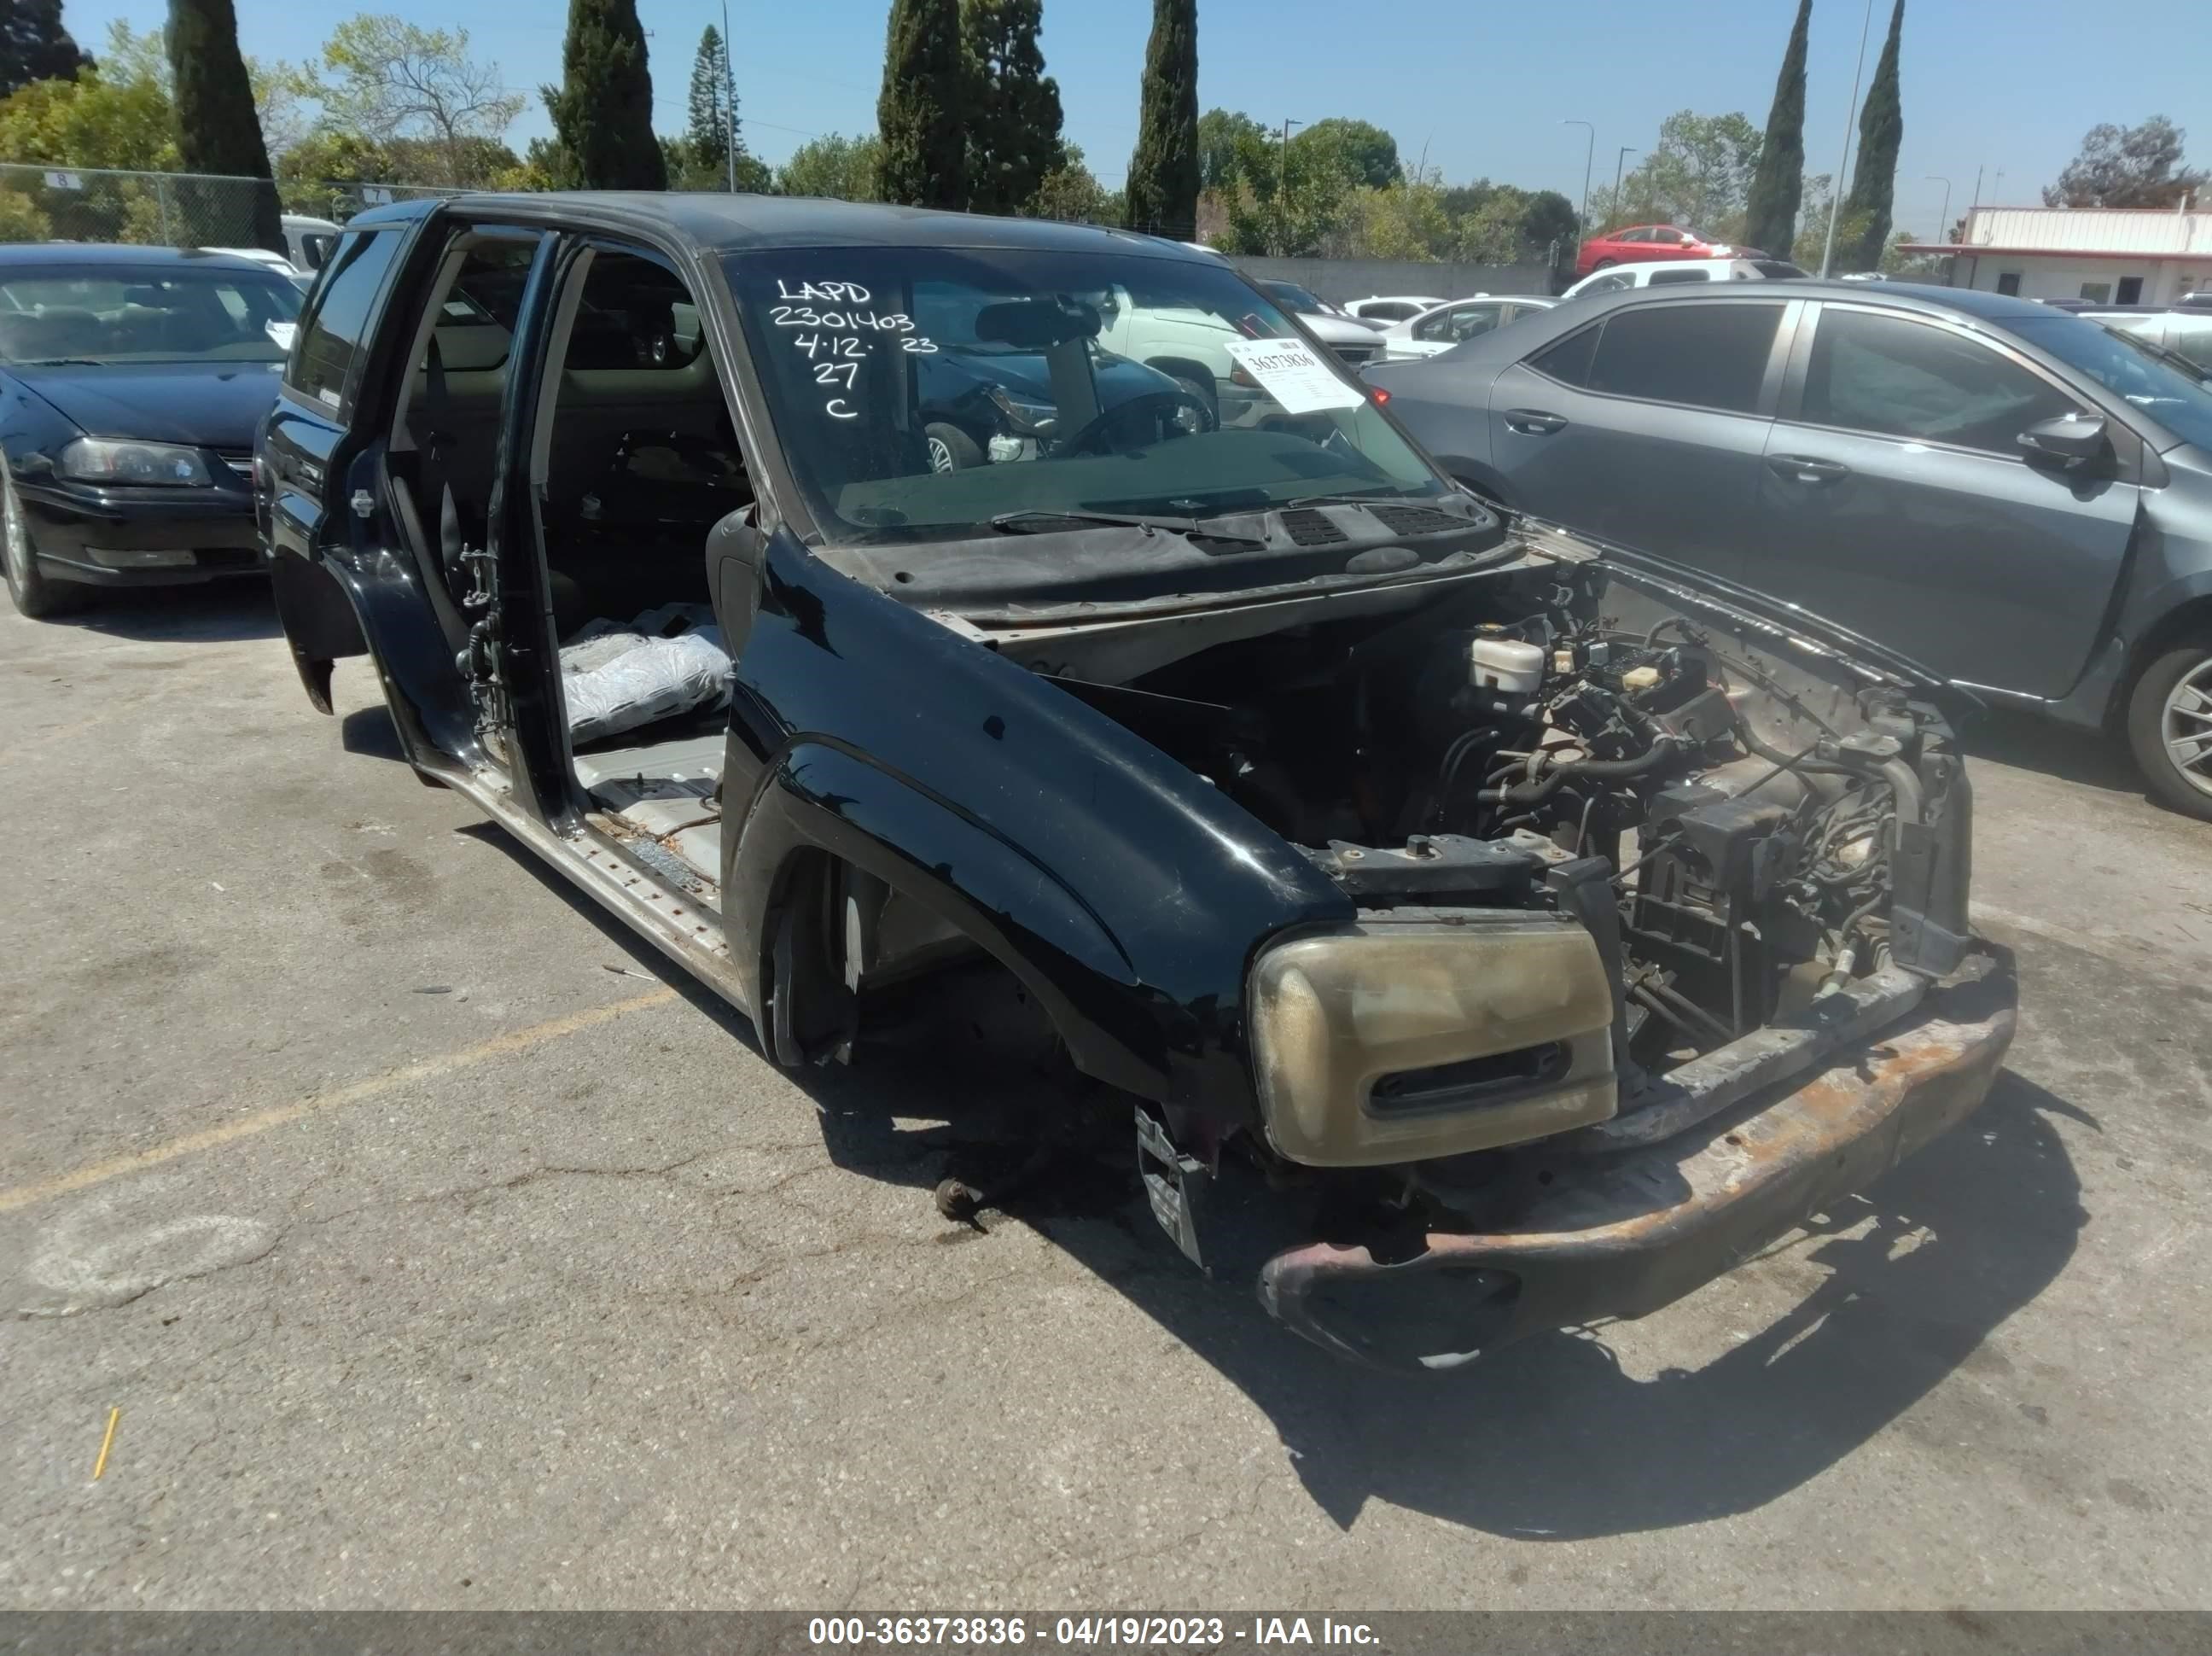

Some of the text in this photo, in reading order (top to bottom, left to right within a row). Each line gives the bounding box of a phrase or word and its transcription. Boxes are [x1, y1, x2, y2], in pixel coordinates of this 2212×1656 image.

[57, 173, 68, 186] 8
[372, 190, 381, 201] 7
[777, 279, 870, 302] LAPD
[770, 306, 915, 332] 2301403
[900, 338, 939, 353] 23
[1249, 353, 1315, 370] 36373836
[813, 362, 859, 389] 27
[826, 399, 859, 417] C
